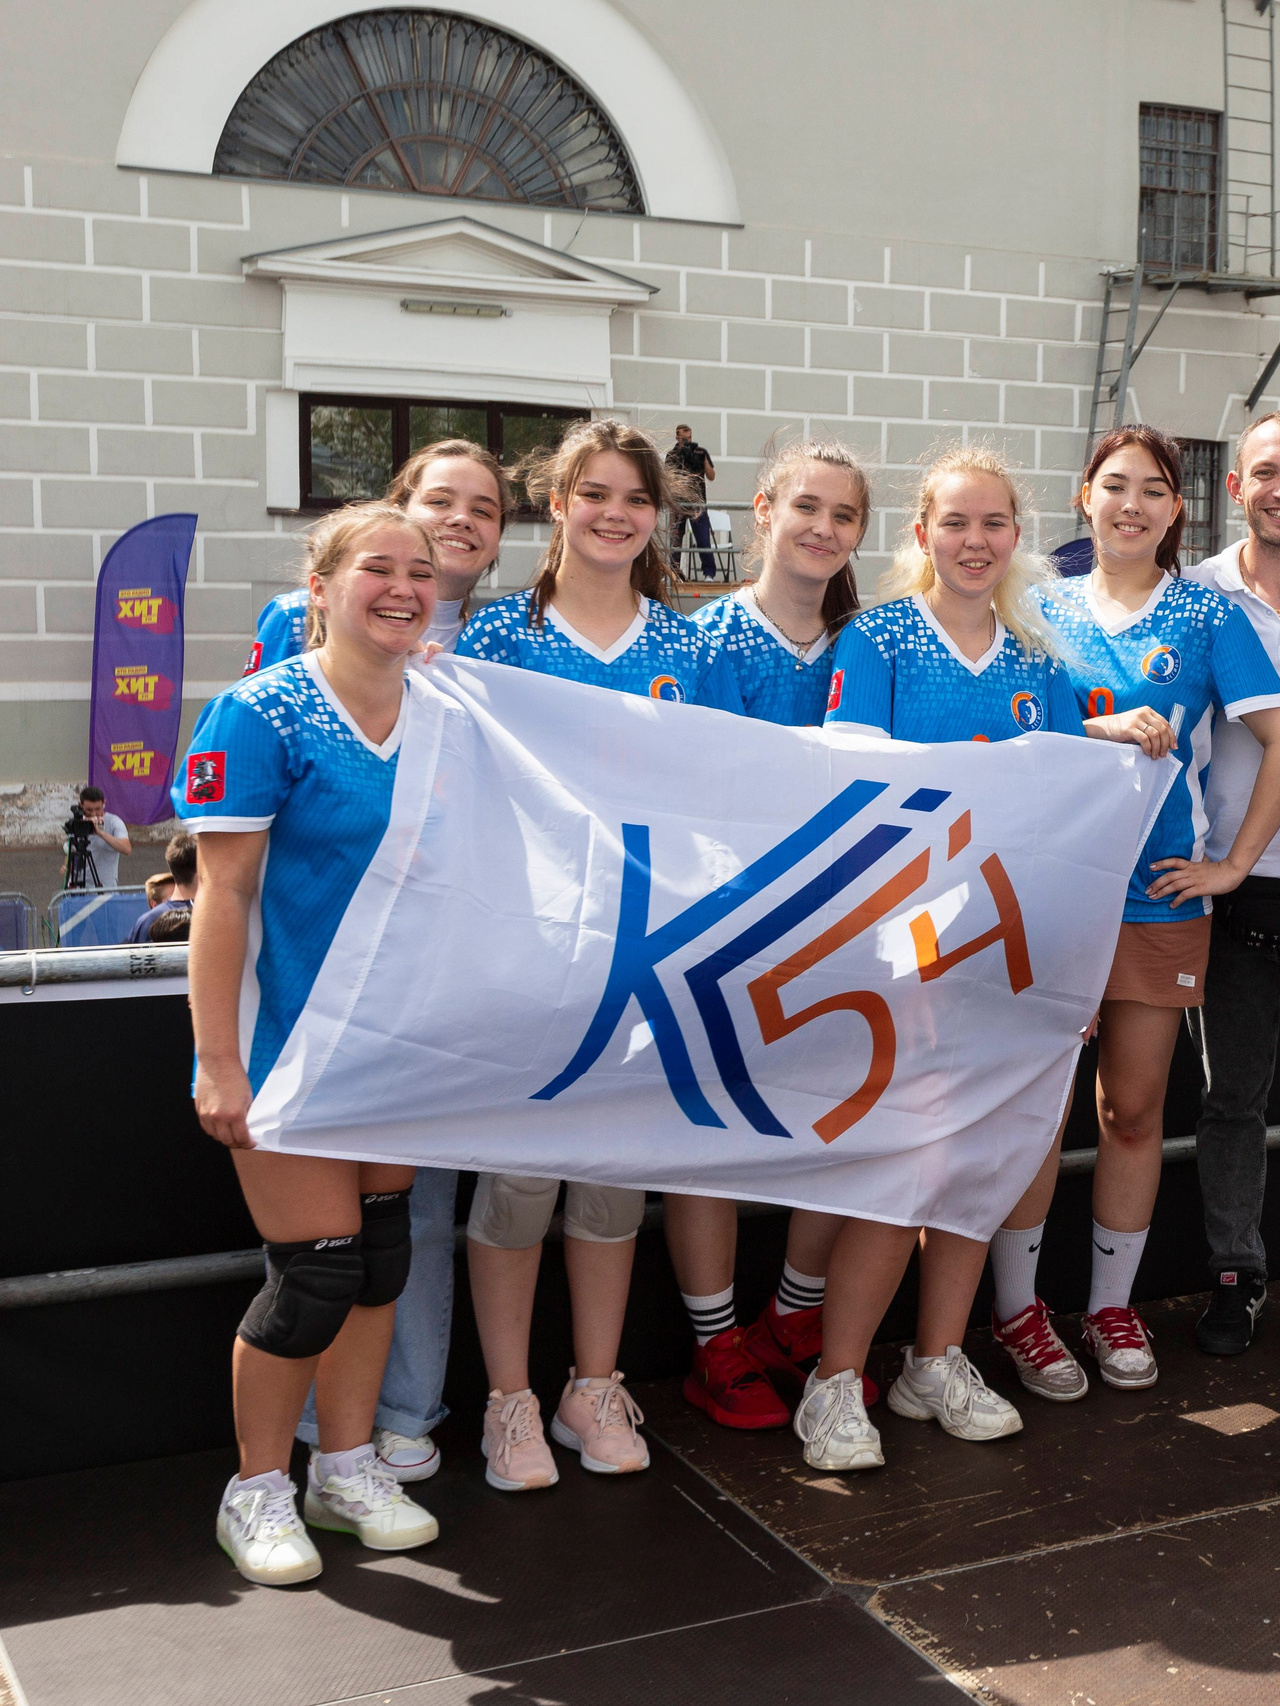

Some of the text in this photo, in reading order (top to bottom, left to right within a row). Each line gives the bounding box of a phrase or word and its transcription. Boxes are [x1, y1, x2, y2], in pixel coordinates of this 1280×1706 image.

[118, 598, 162, 624] ХИТ
[115, 675, 158, 701] ХИТ
[111, 751, 154, 777] ХИТ
[1250, 930, 1265, 940] НЕ
[328, 1237, 353, 1247] asics
